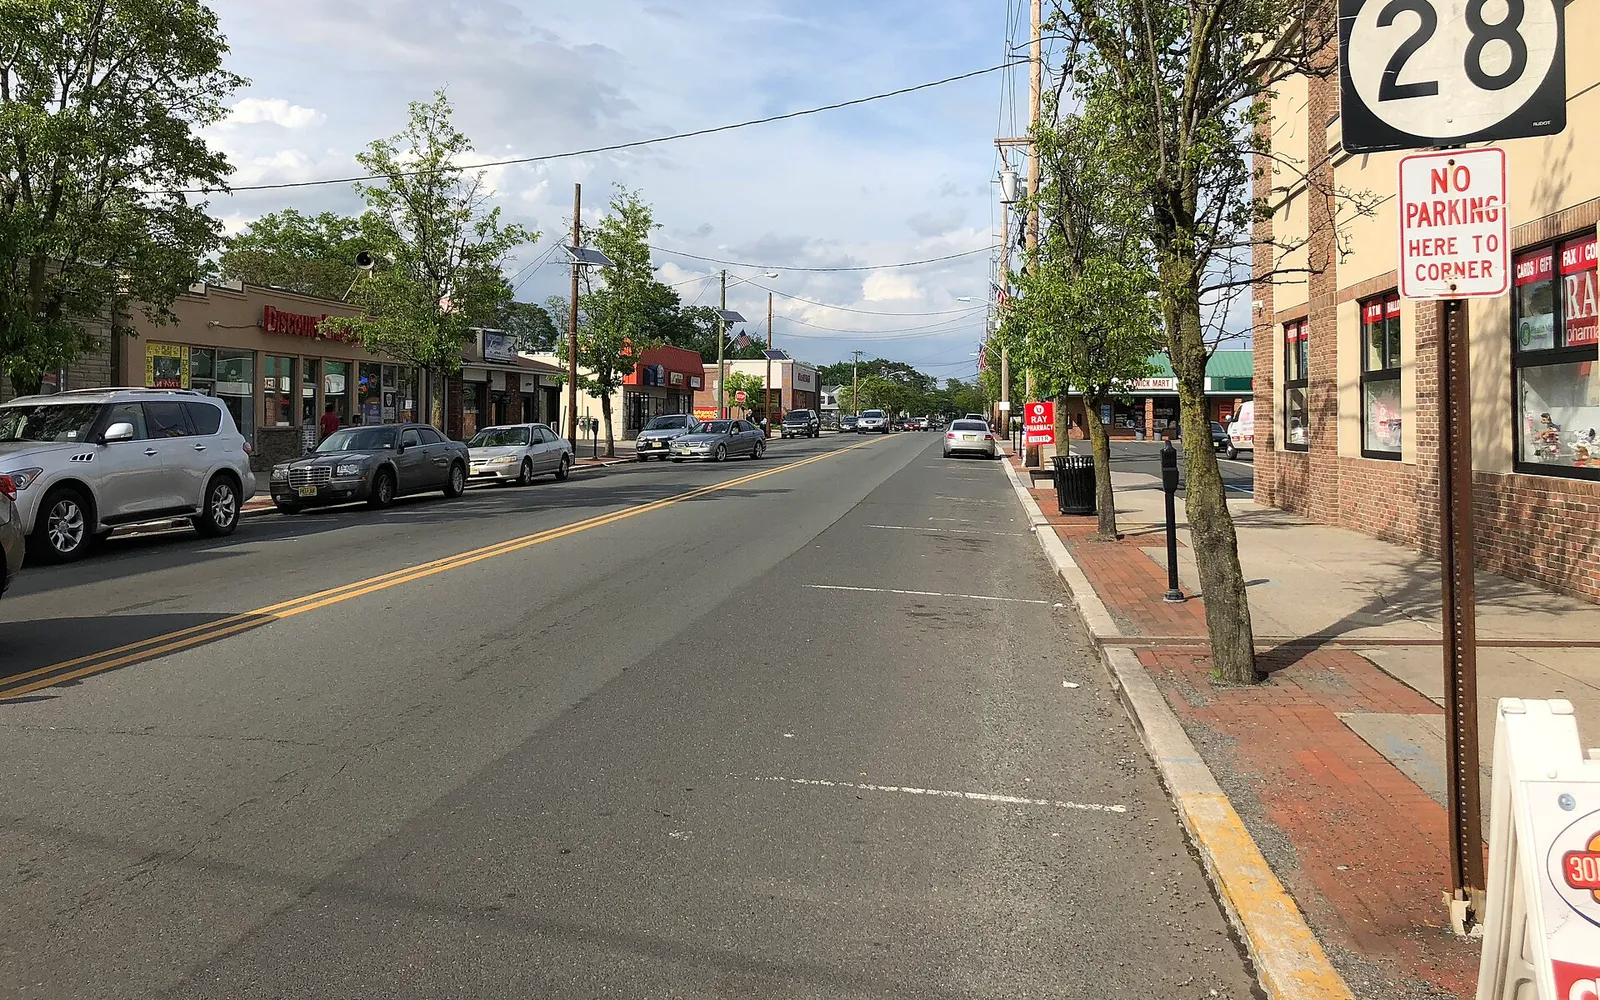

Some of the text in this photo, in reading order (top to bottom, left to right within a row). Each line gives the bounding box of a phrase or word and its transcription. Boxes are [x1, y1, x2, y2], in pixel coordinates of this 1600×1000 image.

[1376, 0, 1528, 102] 28
[1431, 165, 1471, 194] NO
[1406, 195, 1499, 228] PARKING
[1409, 234, 1499, 257] HERE TO
[1562, 248, 1577, 267] FAX
[1415, 260, 1493, 281] CORNER
[1516, 260, 1534, 279] CARDS
[1368, 303, 1381, 317] ATM
[264, 305, 319, 338] DISCOUN
[1152, 379, 1170, 387] MART
[1026, 424, 1054, 432] PHARMACY
[1030, 415, 1048, 424] RAY
